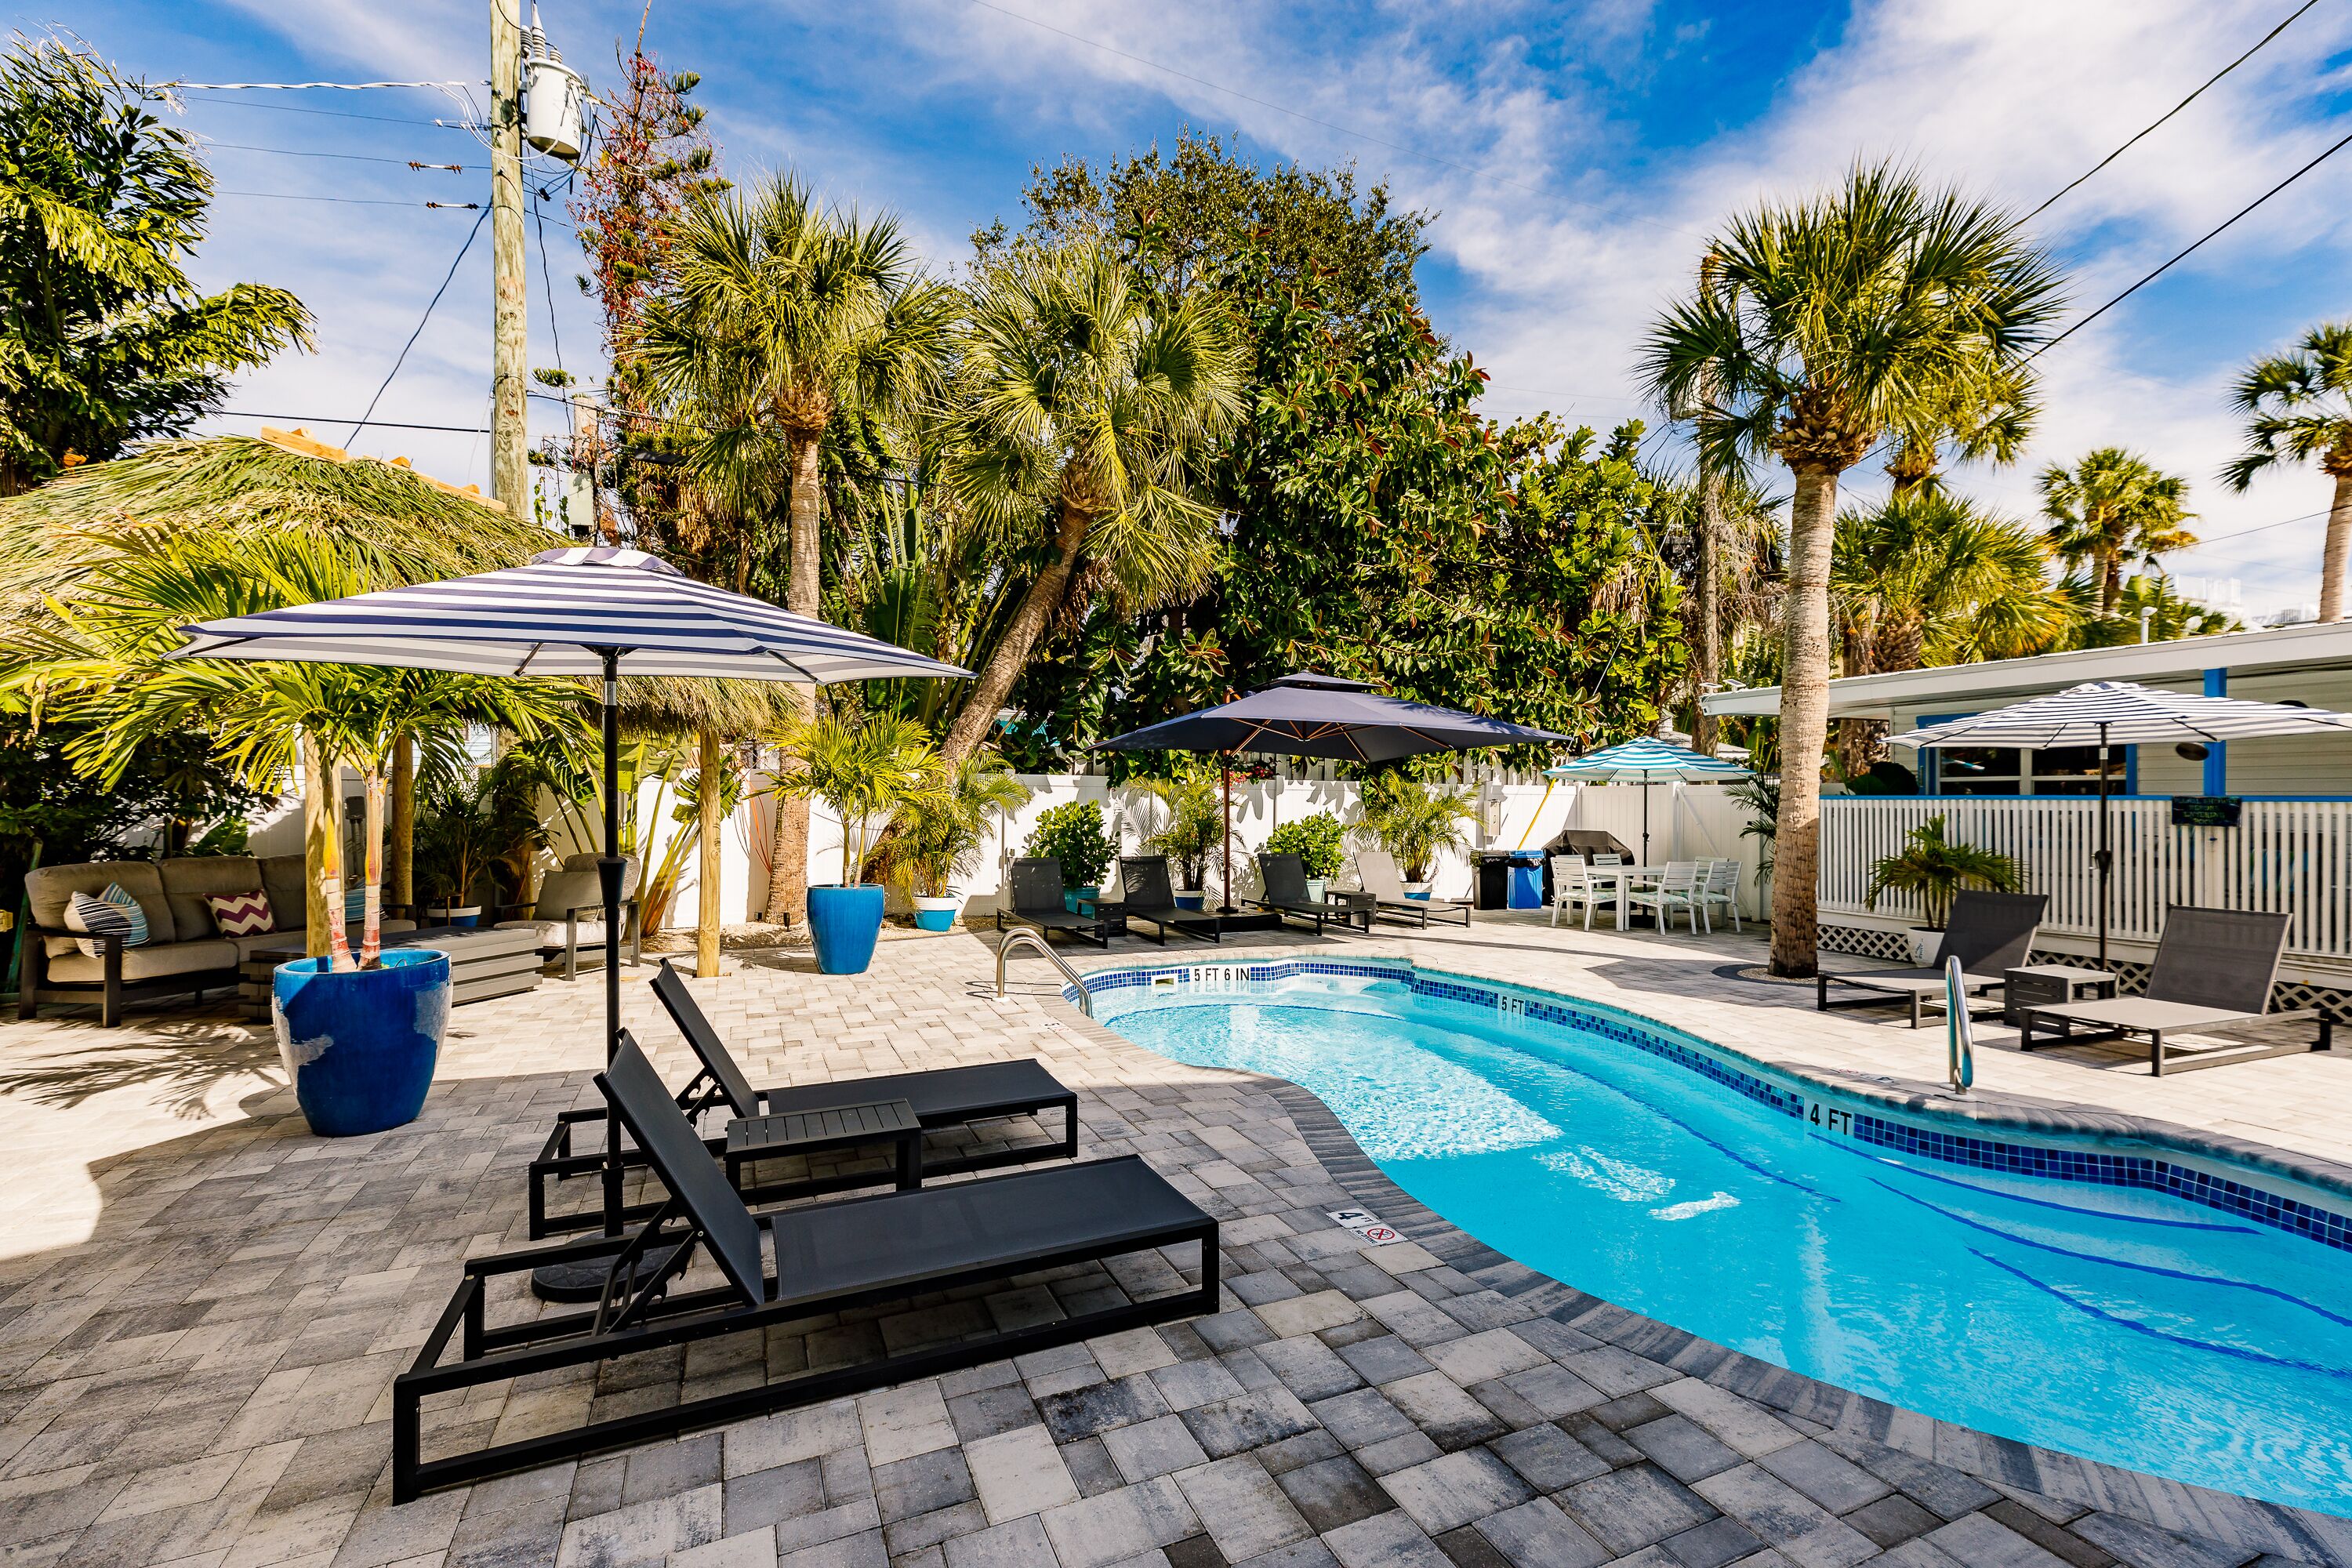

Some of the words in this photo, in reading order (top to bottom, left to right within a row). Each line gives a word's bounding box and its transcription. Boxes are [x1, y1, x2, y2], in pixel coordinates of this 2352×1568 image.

[1194, 968, 1200, 982] 5
[1205, 967, 1219, 982] FT
[1224, 967, 1231, 981] 6
[1236, 967, 1250, 981] IN
[1501, 996, 1508, 1011] 5
[1512, 997, 1525, 1015] FT
[1809, 1103, 1820, 1126] 4
[1828, 1107, 1853, 1136] FT
